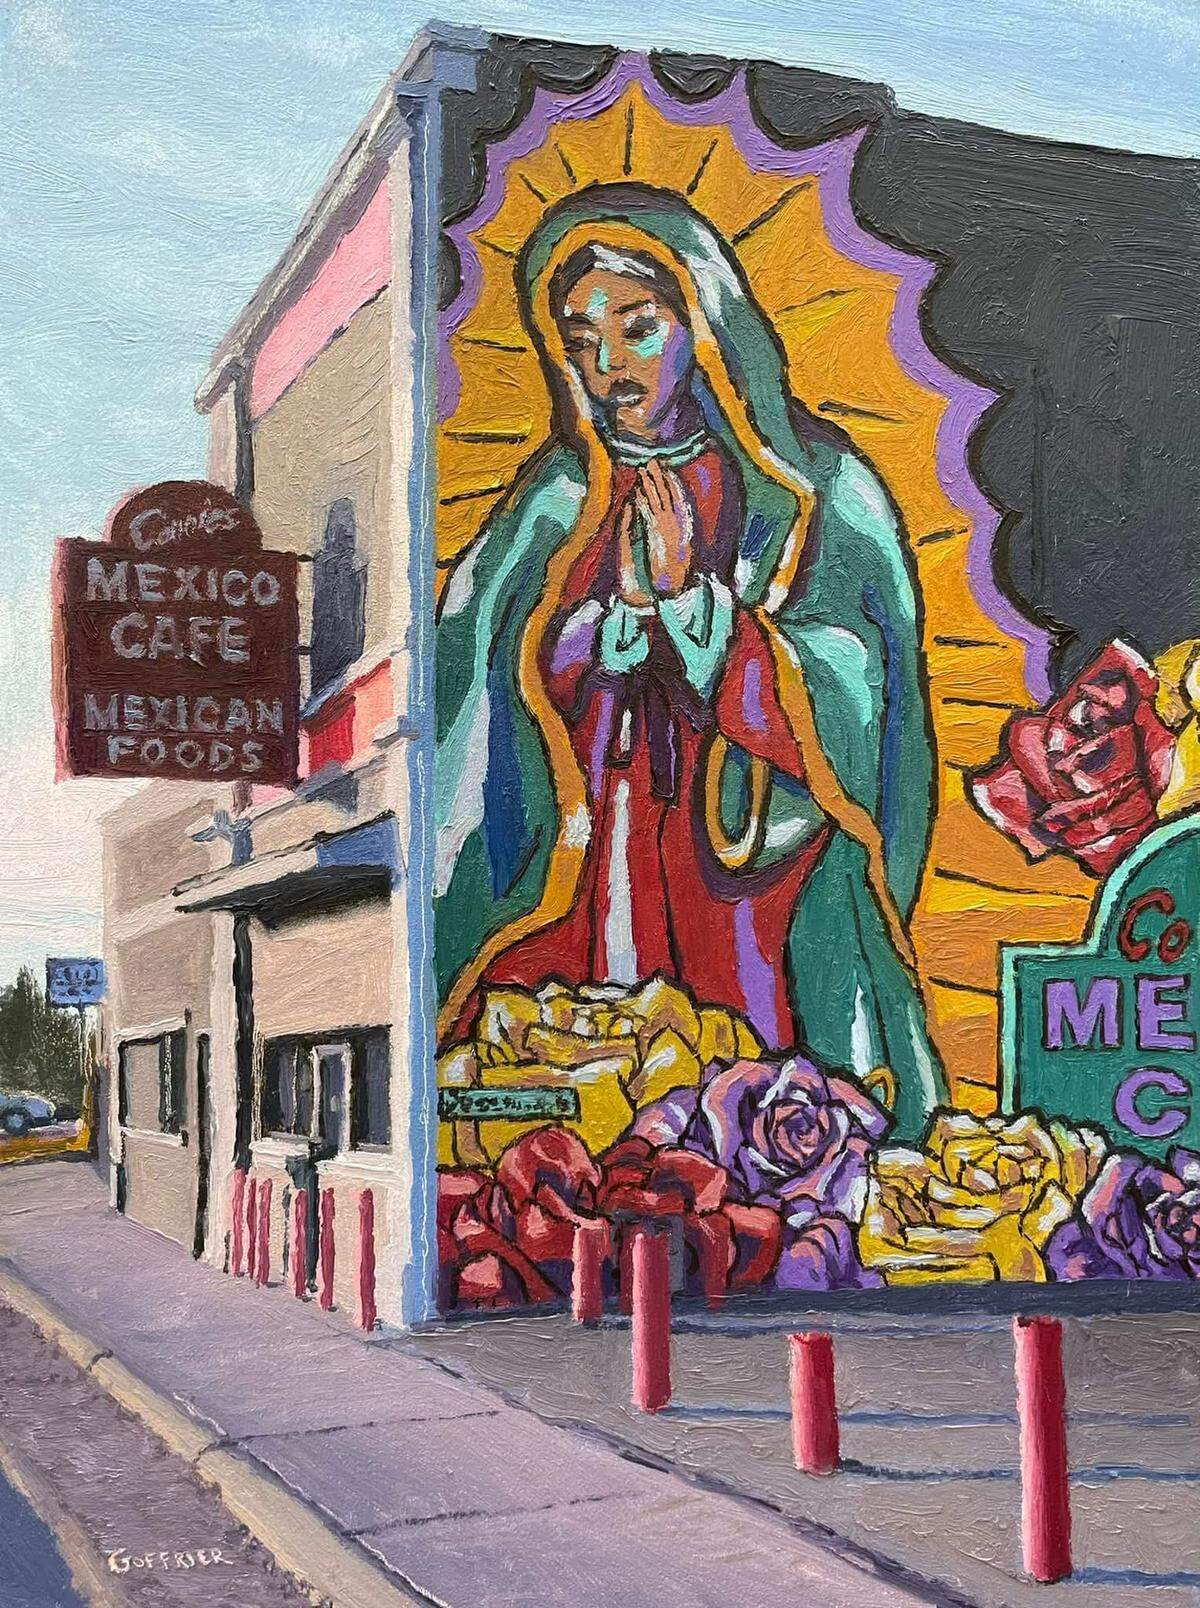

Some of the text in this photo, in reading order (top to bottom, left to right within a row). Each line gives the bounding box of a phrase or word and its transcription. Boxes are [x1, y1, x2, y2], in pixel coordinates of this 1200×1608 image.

[86, 557, 280, 607] MEXICO
[110, 612, 250, 664] CAFE
[83, 694, 284, 734] MEXICAN
[106, 736, 264, 772] FOODS
[1043, 973, 1197, 1051] ME
[1113, 1066, 1192, 1139] C
